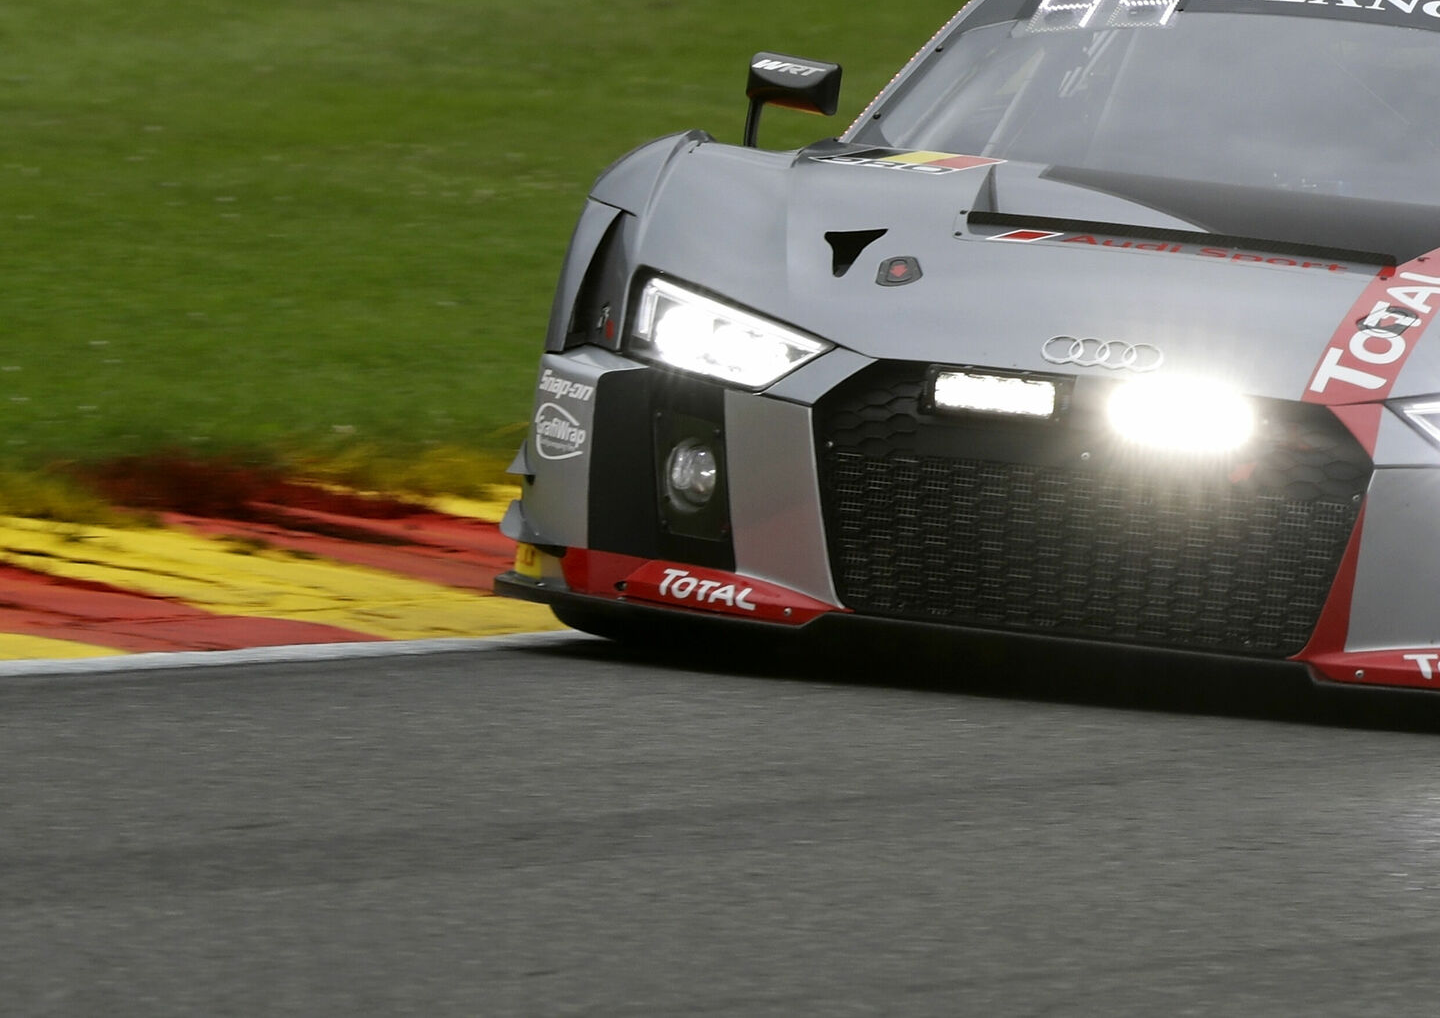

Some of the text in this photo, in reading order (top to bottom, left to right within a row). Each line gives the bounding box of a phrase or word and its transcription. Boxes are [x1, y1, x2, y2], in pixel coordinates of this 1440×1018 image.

[752, 59, 826, 77] WRT
[1063, 235, 1349, 272] Audi Sport
[539, 369, 594, 401] Snap-on
[659, 568, 756, 611] TOTAL
